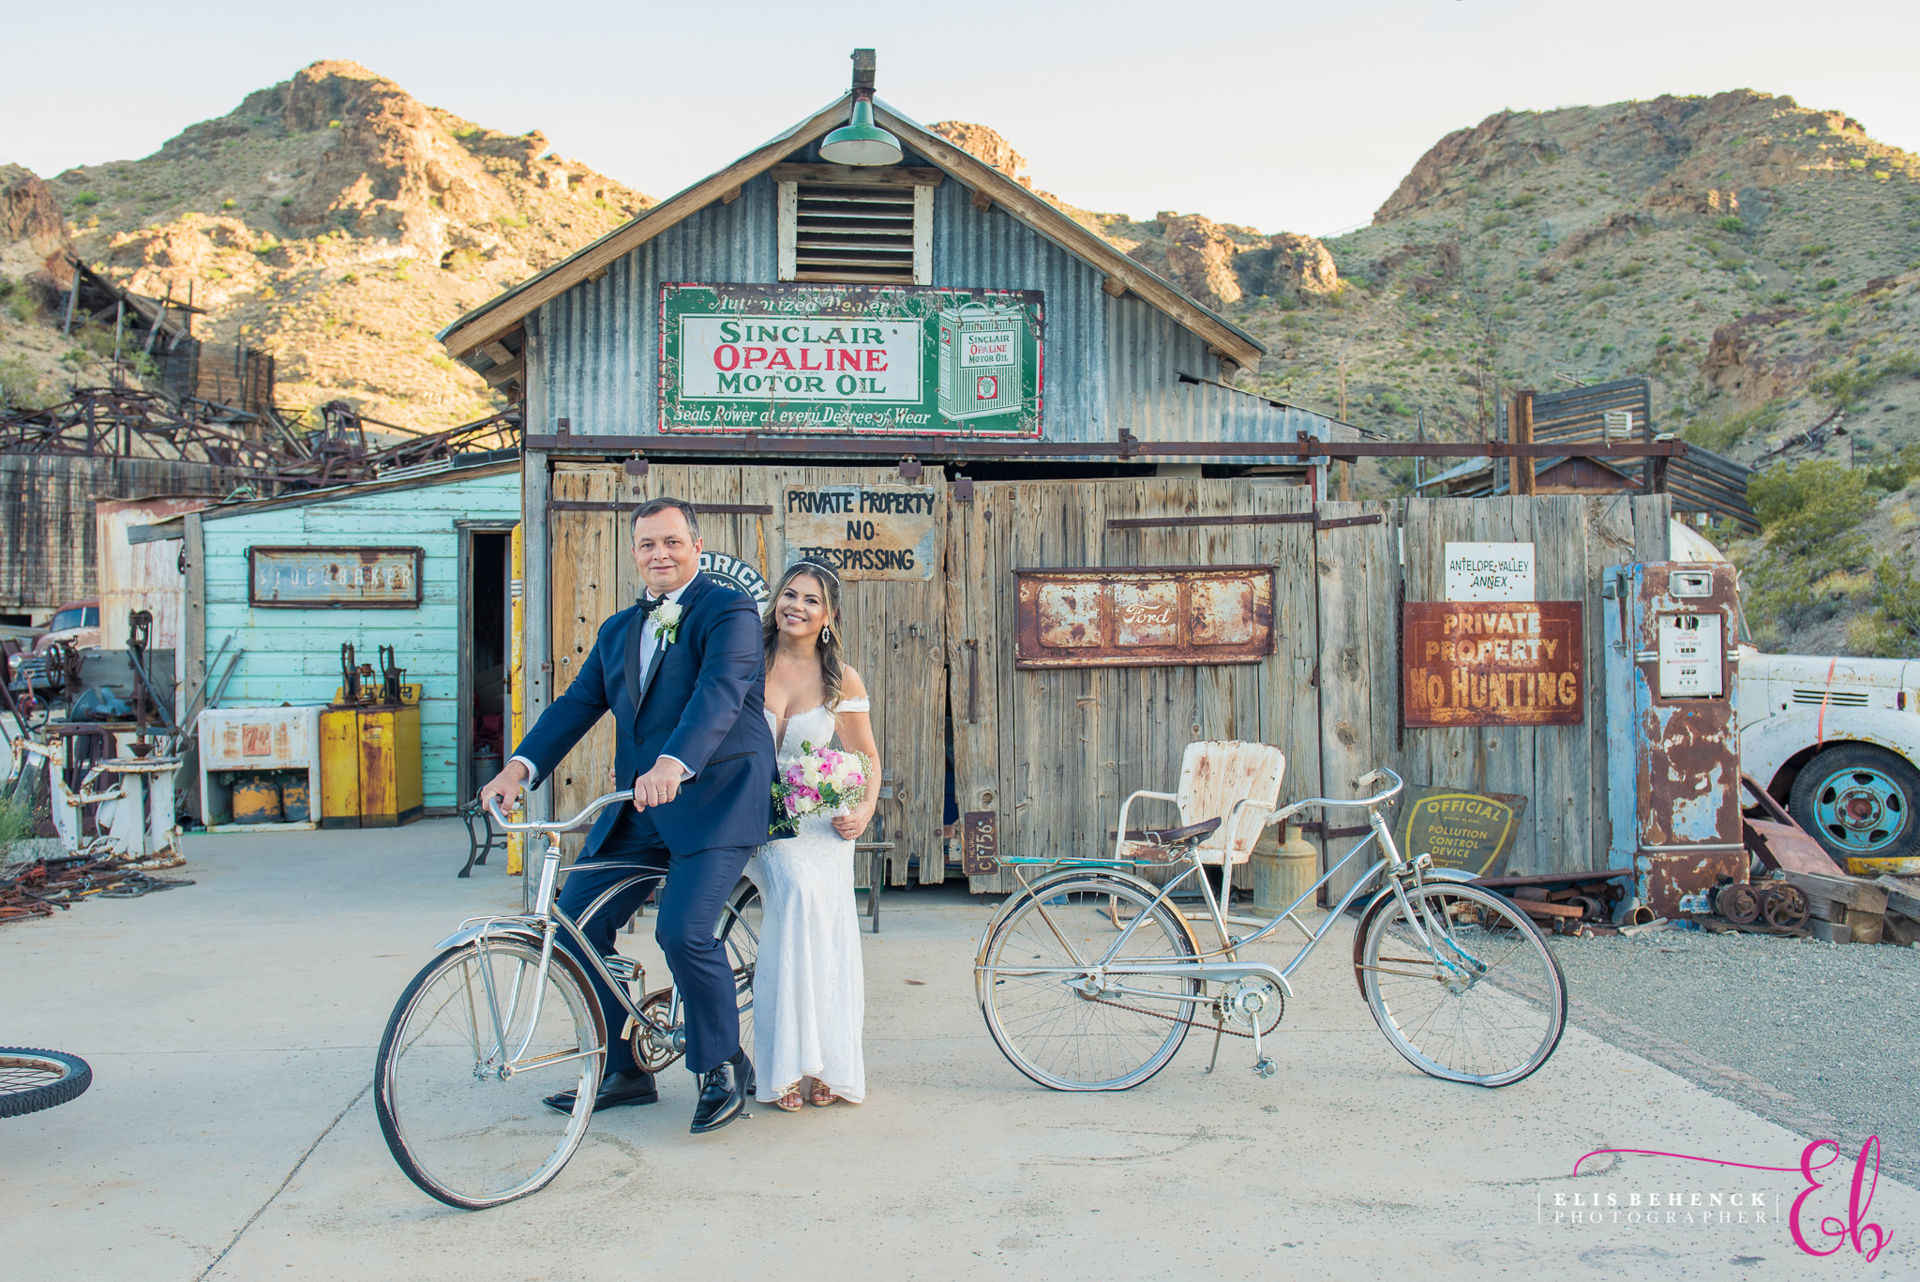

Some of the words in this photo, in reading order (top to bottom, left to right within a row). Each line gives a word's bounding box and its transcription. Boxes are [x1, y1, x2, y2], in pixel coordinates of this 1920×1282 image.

[708, 293, 817, 313] Autorized
[720, 321, 885, 344] SINCLAIR
[969, 335, 1010, 344] SINCLAIR
[713, 344, 889, 372] OPALINE
[968, 354, 994, 364] MOTOR
[995, 353, 1009, 362] OIL
[716, 372, 826, 394] MOTOR
[836, 374, 886, 395] OIL
[674, 404, 711, 421] Seals
[714, 405, 757, 422] Power
[760, 407, 776, 422] at
[780, 409, 820, 426] every
[822, 406, 873, 426] Degree
[874, 408, 891, 427] of
[895, 407, 931, 425] Wear
[788, 491, 854, 514] PRIVATE
[860, 491, 935, 515] PROPERTY
[847, 520, 875, 541] NO
[1450, 560, 1494, 572] ANTELOPE
[1499, 560, 1529, 572] VALLEY
[1472, 576, 1508, 587] ANNEX
[1123, 603, 1170, 624] Ford
[1443, 612, 1542, 634] PRIVATE
[1425, 638, 1559, 662] PROPERTY
[1410, 667, 1445, 708] NO
[1451, 666, 1577, 708] HUNTING
[1427, 800, 1501, 822] OFFICIAL
[1428, 825, 1488, 839] POLLUTION
[1429, 835, 1479, 849] CONTROL
[1432, 846, 1470, 858] DEVICE
